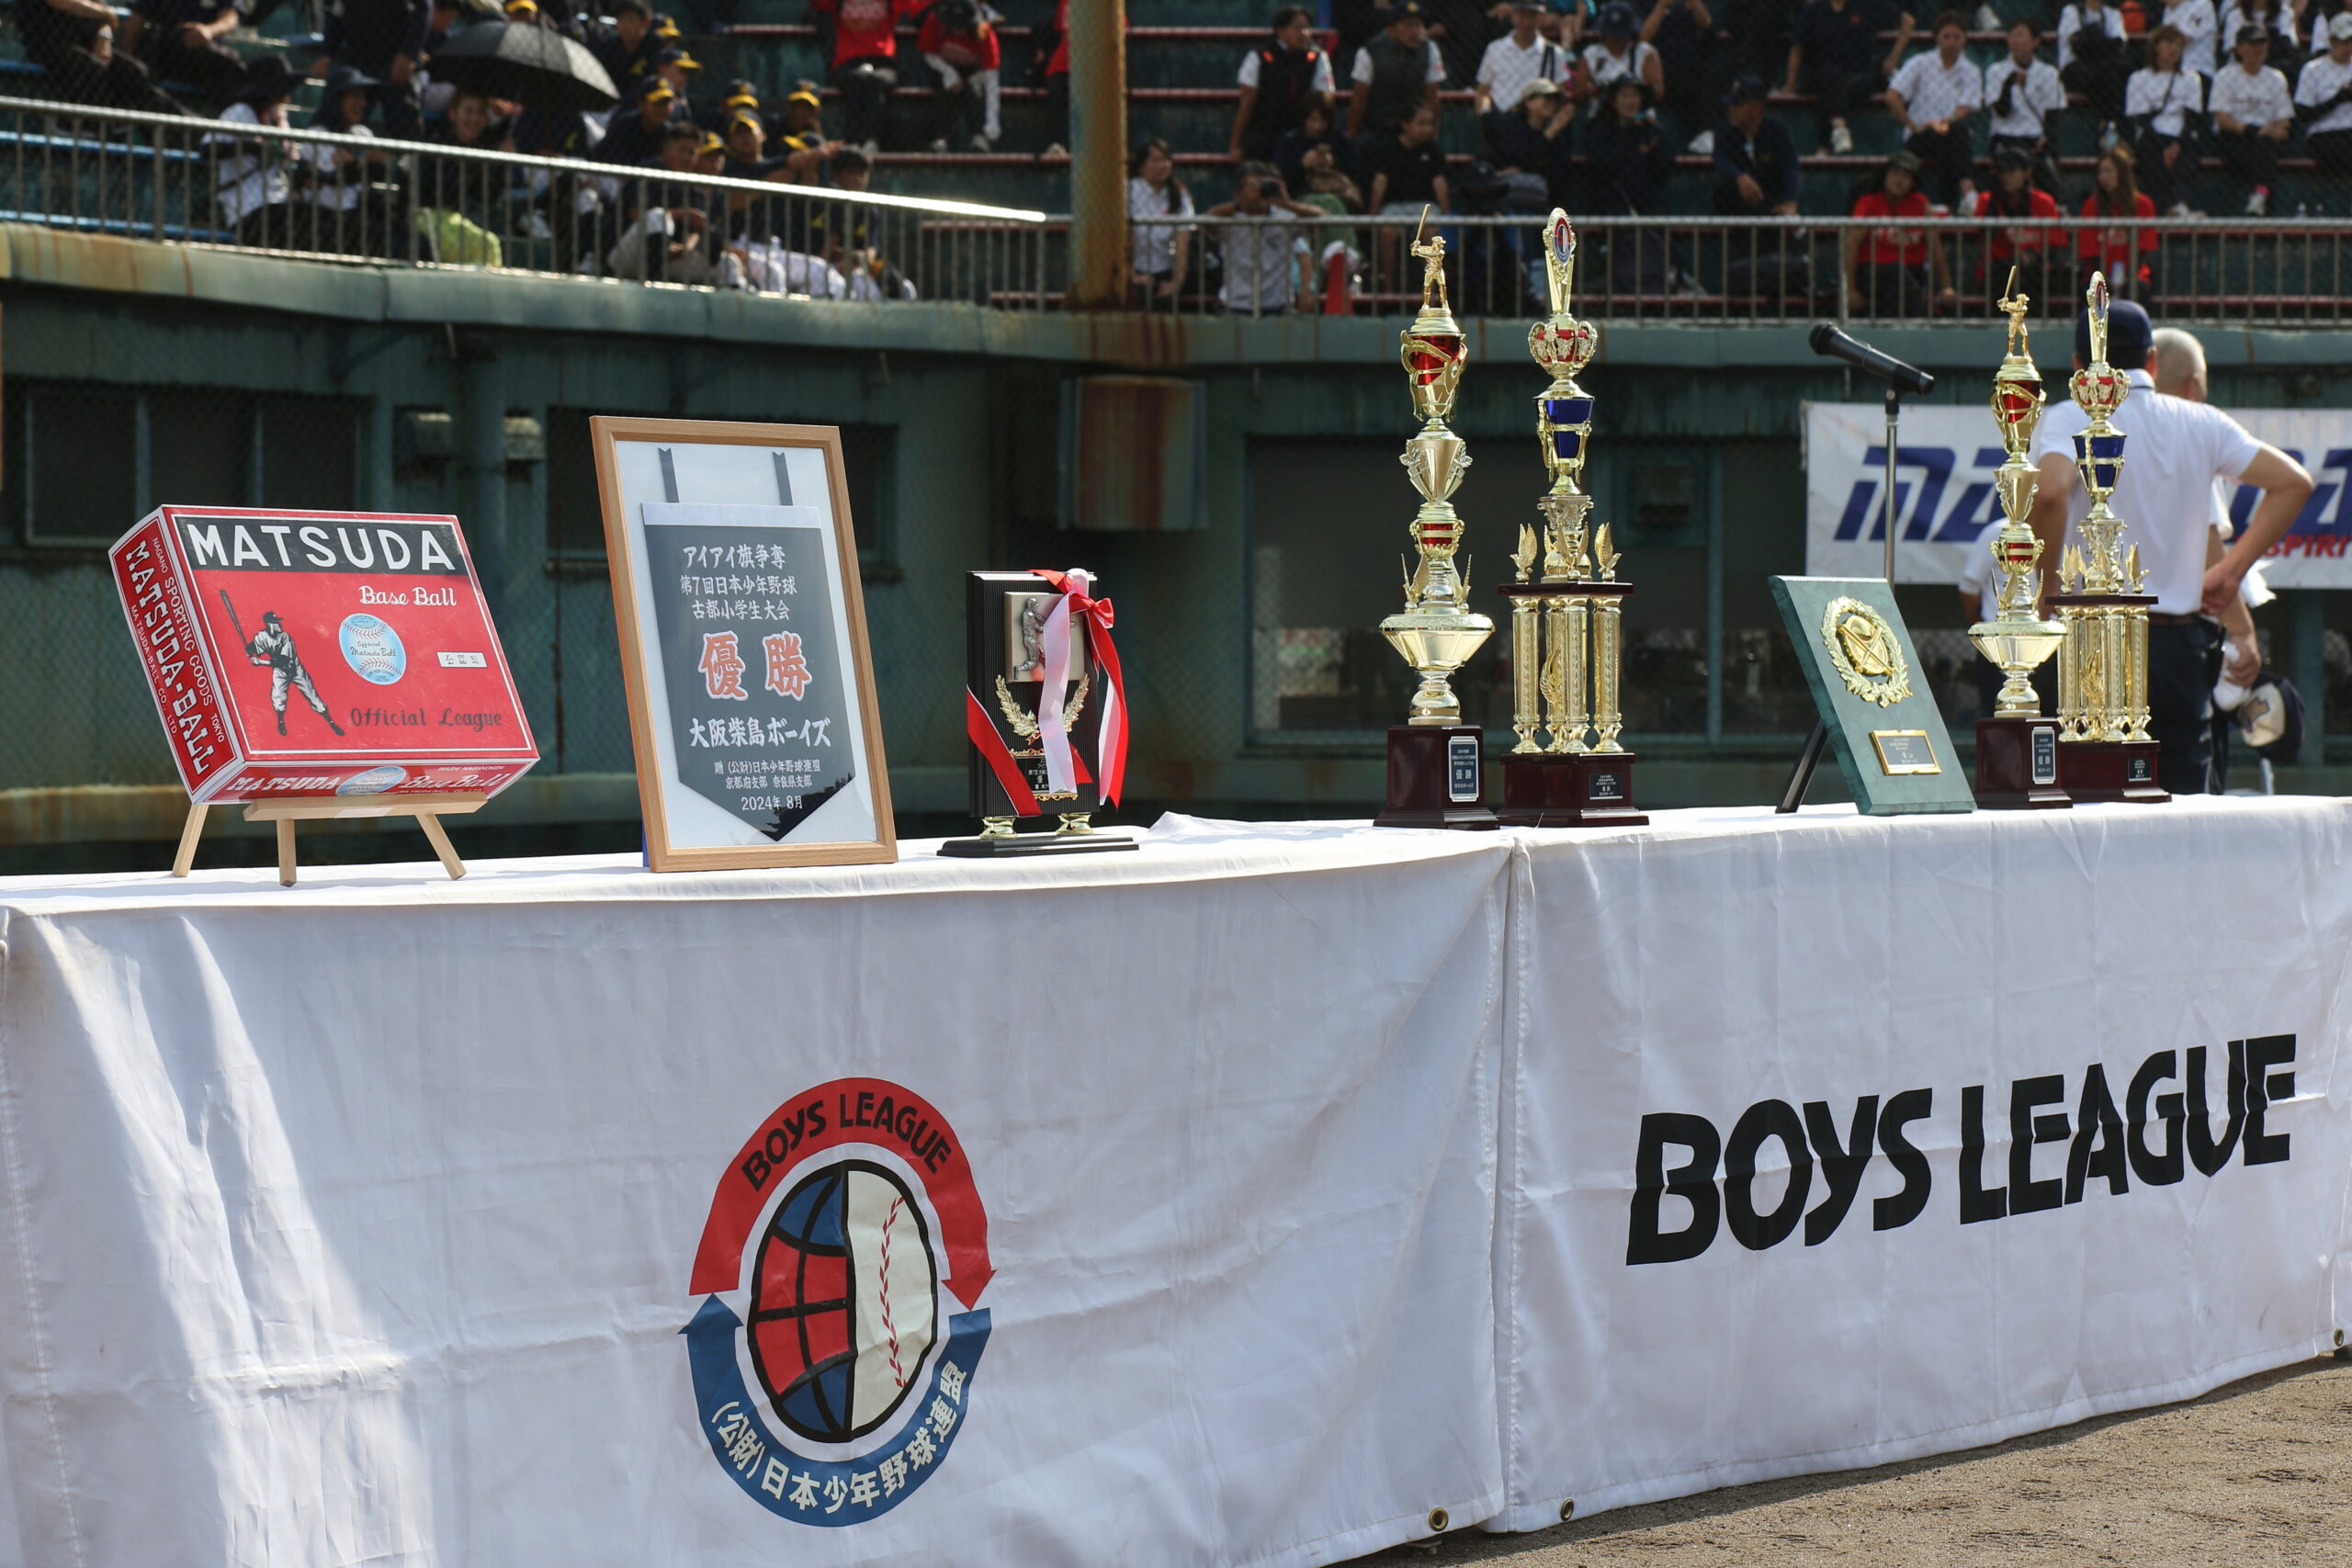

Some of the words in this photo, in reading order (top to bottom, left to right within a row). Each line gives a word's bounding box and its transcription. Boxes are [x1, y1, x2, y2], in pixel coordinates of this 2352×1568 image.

[187, 525, 456, 570] MATSUDA
[683, 544, 786, 570] アイアイ旗争奪
[359, 585, 408, 604] Base
[413, 587, 457, 606] Ball
[680, 574, 797, 595] 第7回日本少年野球
[691, 599, 790, 621] 古都小学生大会
[152, 537, 168, 573] NAGANO
[164, 577, 195, 651] SPORTING
[189, 655, 213, 705] GOODS
[210, 714, 225, 742] TOKYO
[350, 707, 427, 727] Official
[437, 707, 503, 733] League
[689, 716, 831, 748] 大阪柴島ボーイズ
[227, 777, 341, 790] MATSUDA
[449, 773, 512, 787] Ball
[726, 776, 768, 790] 京都府支部
[773, 774, 812, 788] 奈良県支部
[741, 795, 782, 811] 2024年
[786, 795, 803, 809] 8月
[741, 1100, 828, 1191] BOYS
[839, 1092, 952, 1175] LEAGUE
[1626, 1087, 1932, 1266] BOYS
[1959, 1033, 2297, 1225] LEAGUE
